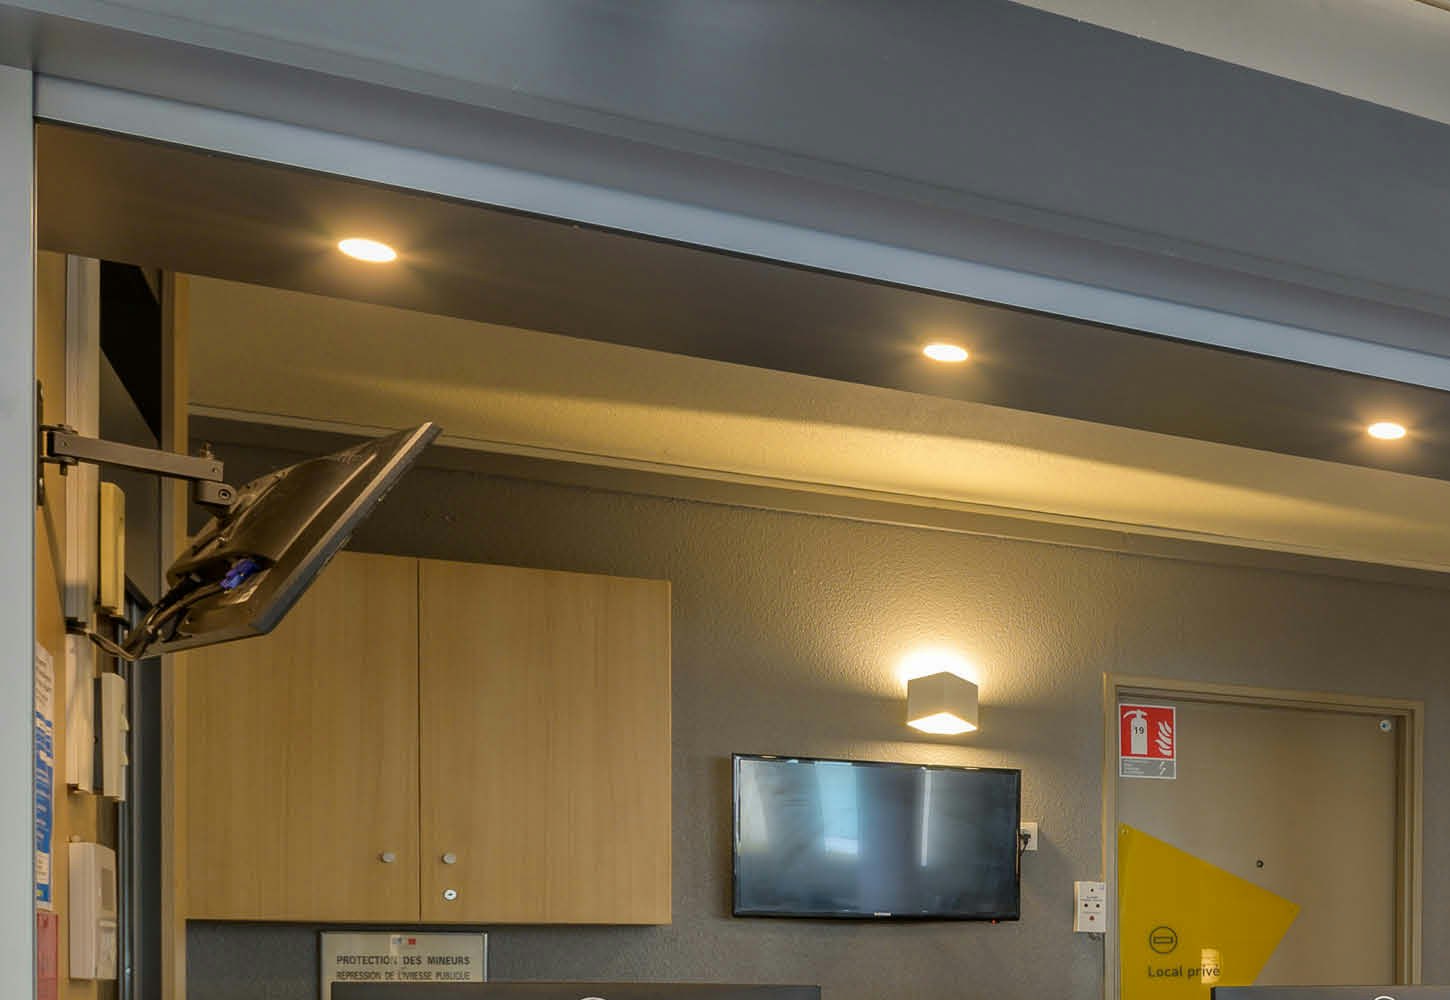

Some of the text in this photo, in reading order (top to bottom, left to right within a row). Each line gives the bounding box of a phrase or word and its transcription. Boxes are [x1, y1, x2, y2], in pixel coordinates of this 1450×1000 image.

[1134, 726, 1145, 735] 19
[336, 955, 471, 965] PROTECTION DES MINEURS
[1148, 966, 1183, 977] Local
